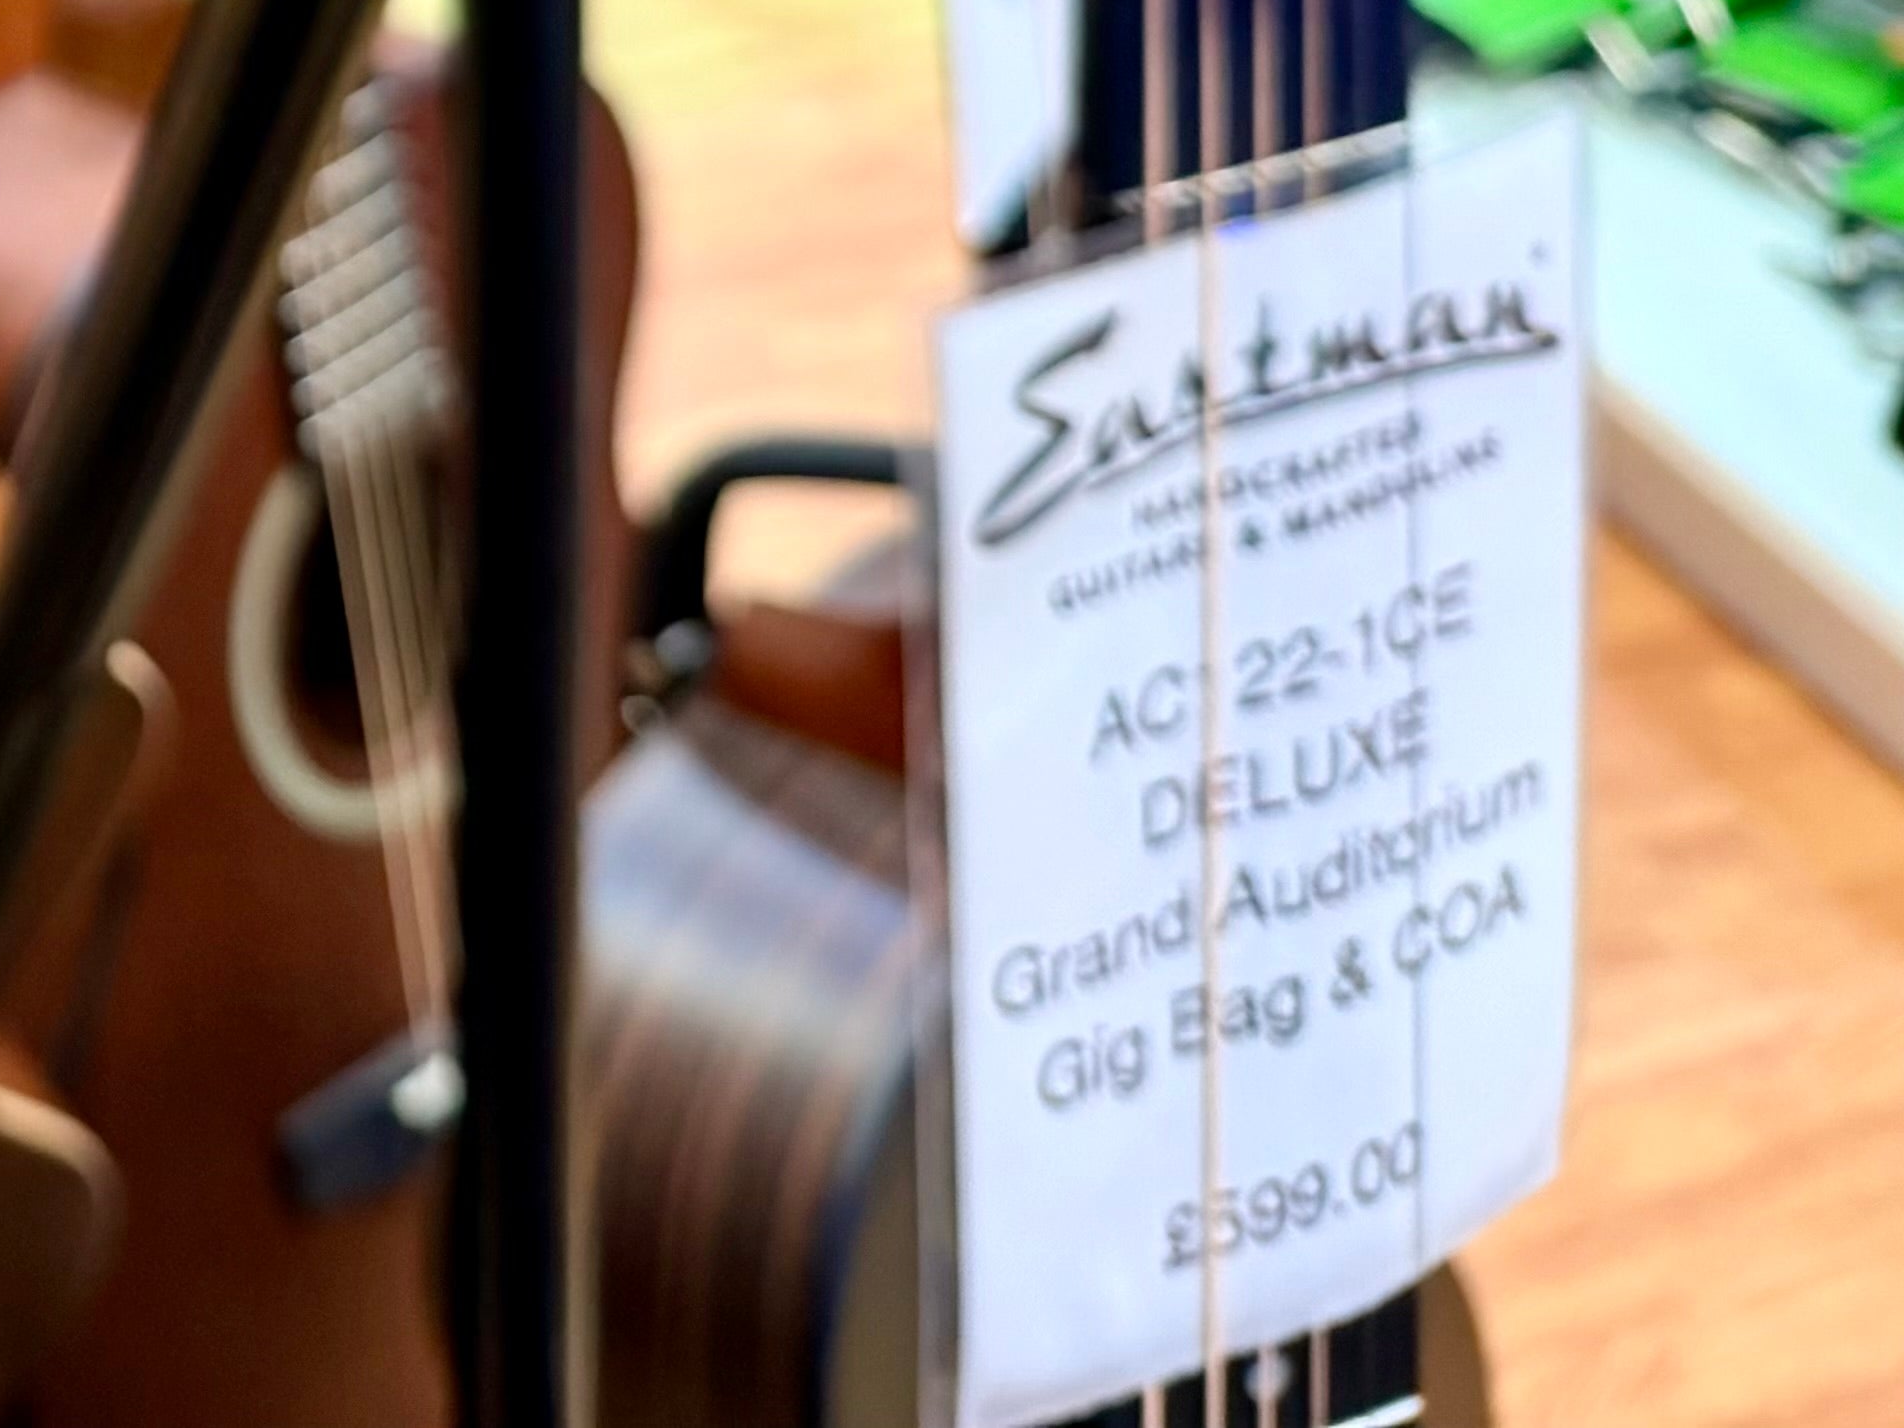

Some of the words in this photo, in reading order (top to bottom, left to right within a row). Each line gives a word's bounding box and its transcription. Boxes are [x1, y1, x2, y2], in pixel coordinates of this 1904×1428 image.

[972, 278, 1560, 548] Eastman
[1090, 560, 1474, 764] AC22-1CE
[1140, 686, 1429, 854] DELUXE
[991, 886, 1195, 1016] Grand
[1212, 758, 1542, 934] Auditorium
[1035, 1022, 1147, 1110] Gig
[1170, 972, 1306, 1056] Bag
[1328, 934, 1374, 1010] &
[1392, 859, 1525, 978] COA
[1162, 1120, 1425, 1276] £599.00
